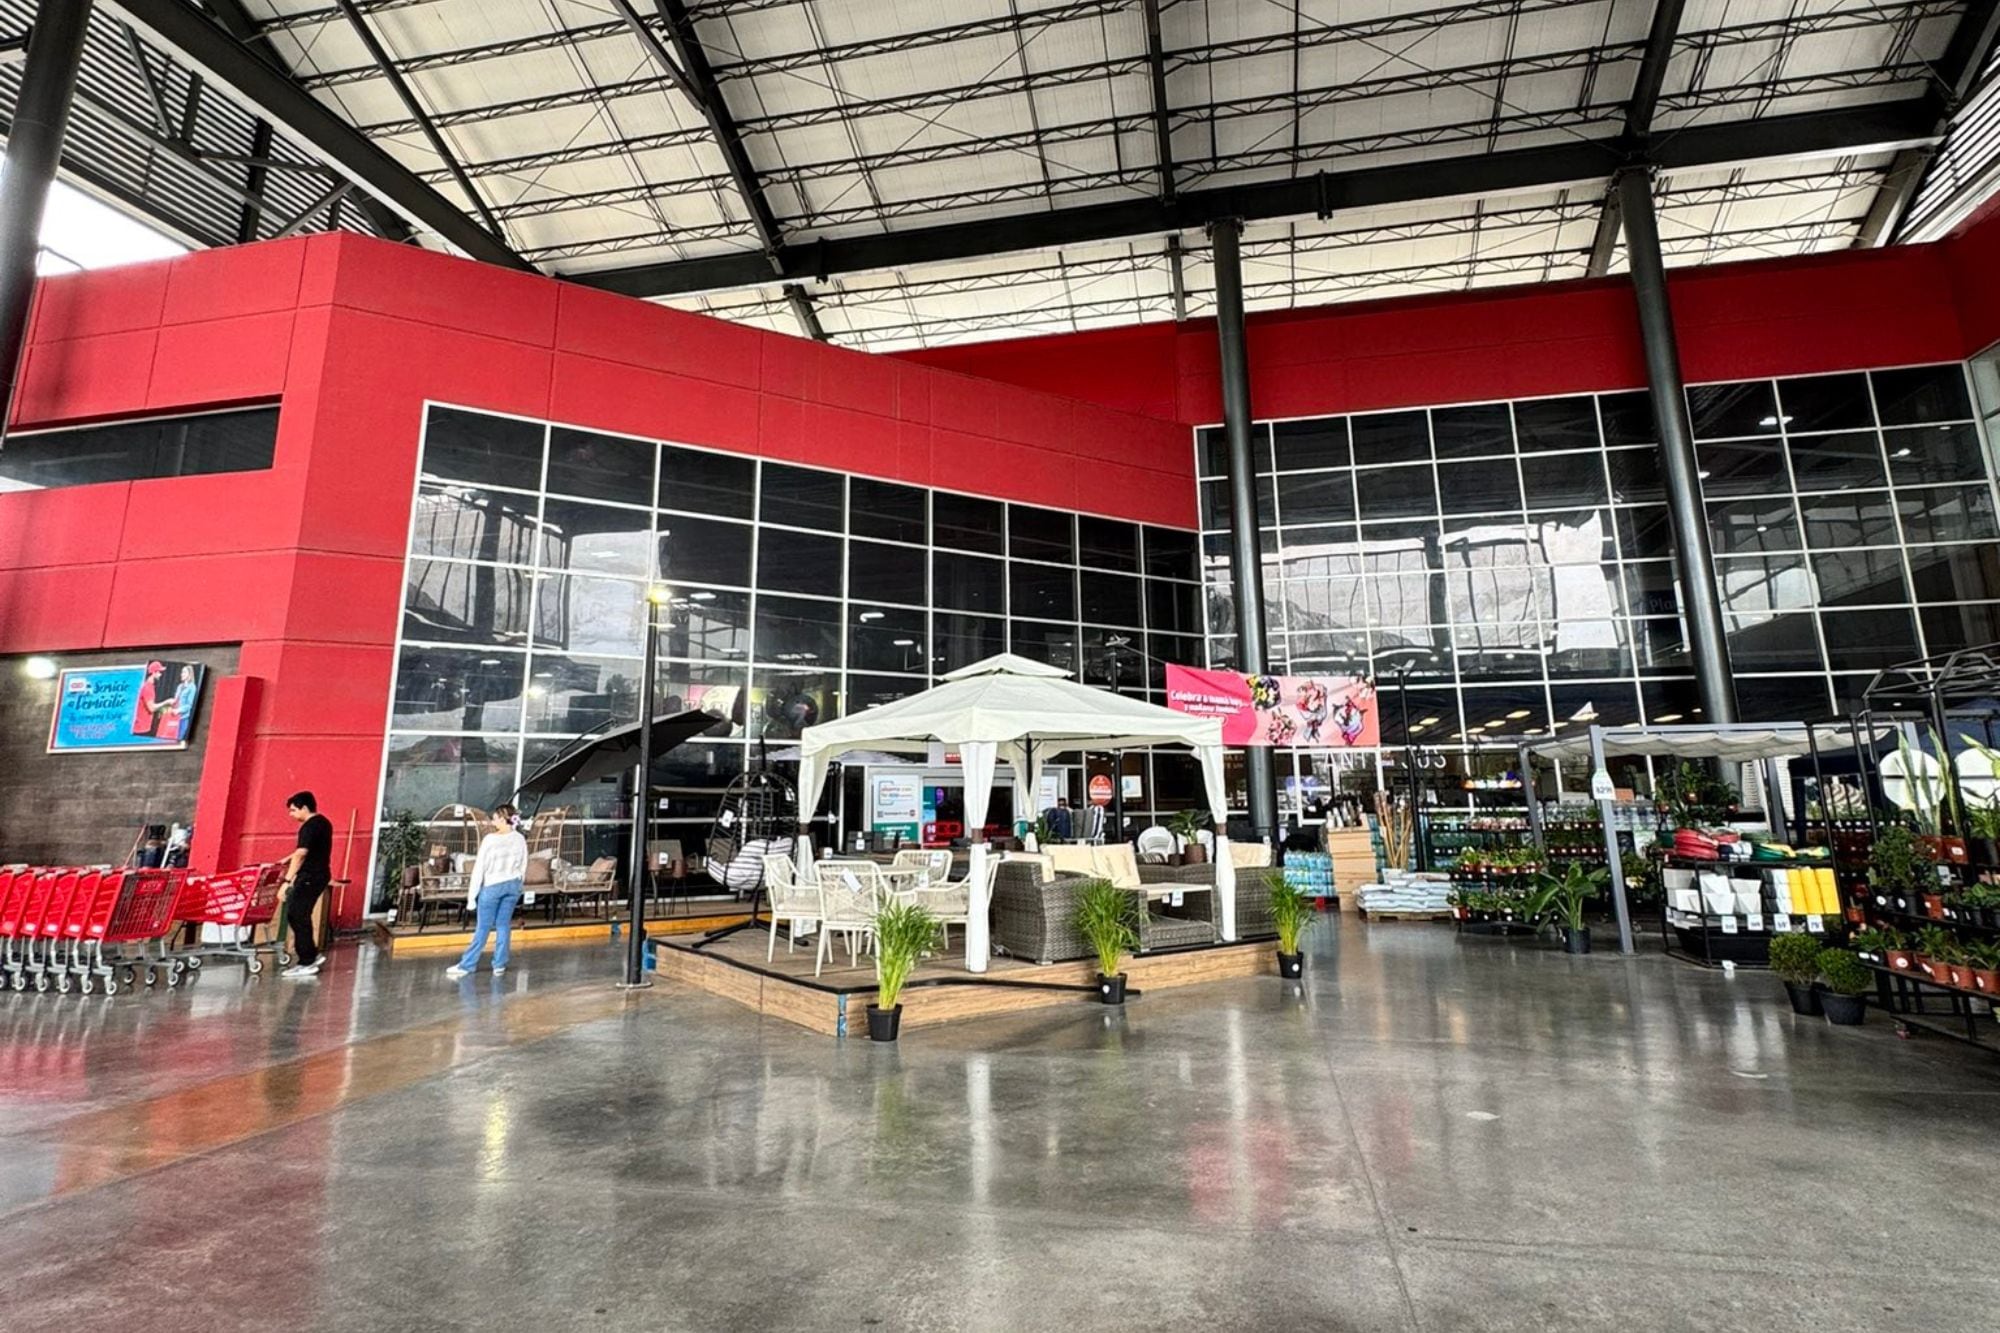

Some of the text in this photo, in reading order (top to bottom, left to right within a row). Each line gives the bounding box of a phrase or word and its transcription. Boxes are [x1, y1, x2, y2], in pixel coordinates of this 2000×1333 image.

[93, 681, 129, 694] Servicio
[76, 693, 126, 710] Domicilio
[1170, 690, 1202, 702] Celebra
